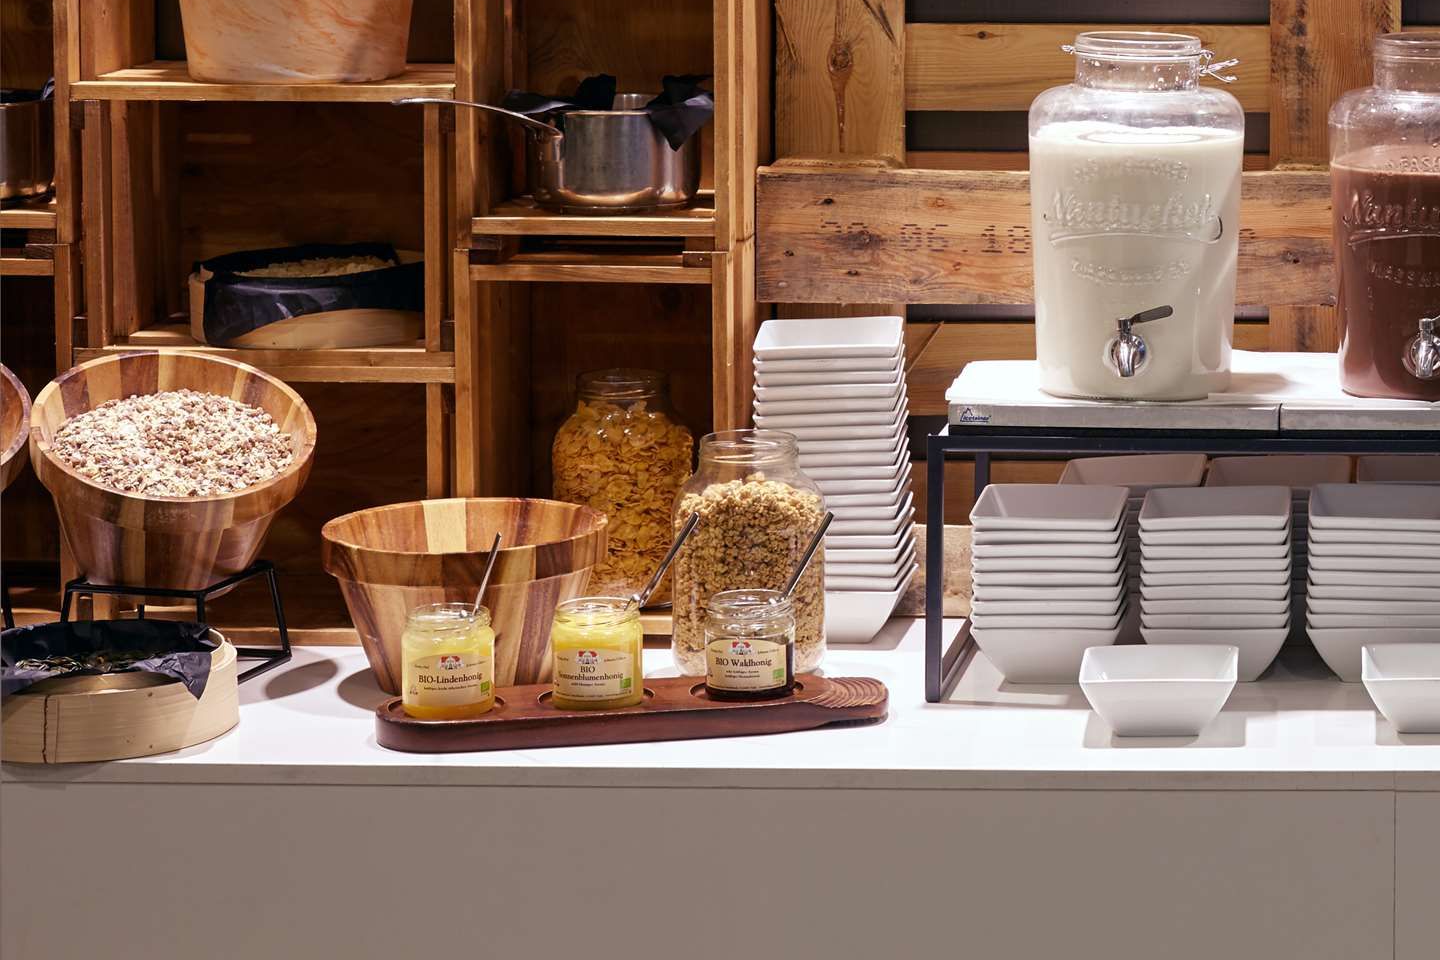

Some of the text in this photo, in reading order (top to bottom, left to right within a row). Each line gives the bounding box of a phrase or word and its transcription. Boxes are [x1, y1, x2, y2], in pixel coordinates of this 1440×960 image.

[715, 657, 772, 667] BIO Waldhonig
[580, 665, 596, 673] BIO
[418, 672, 482, 684] BIO-Lindenhonig
